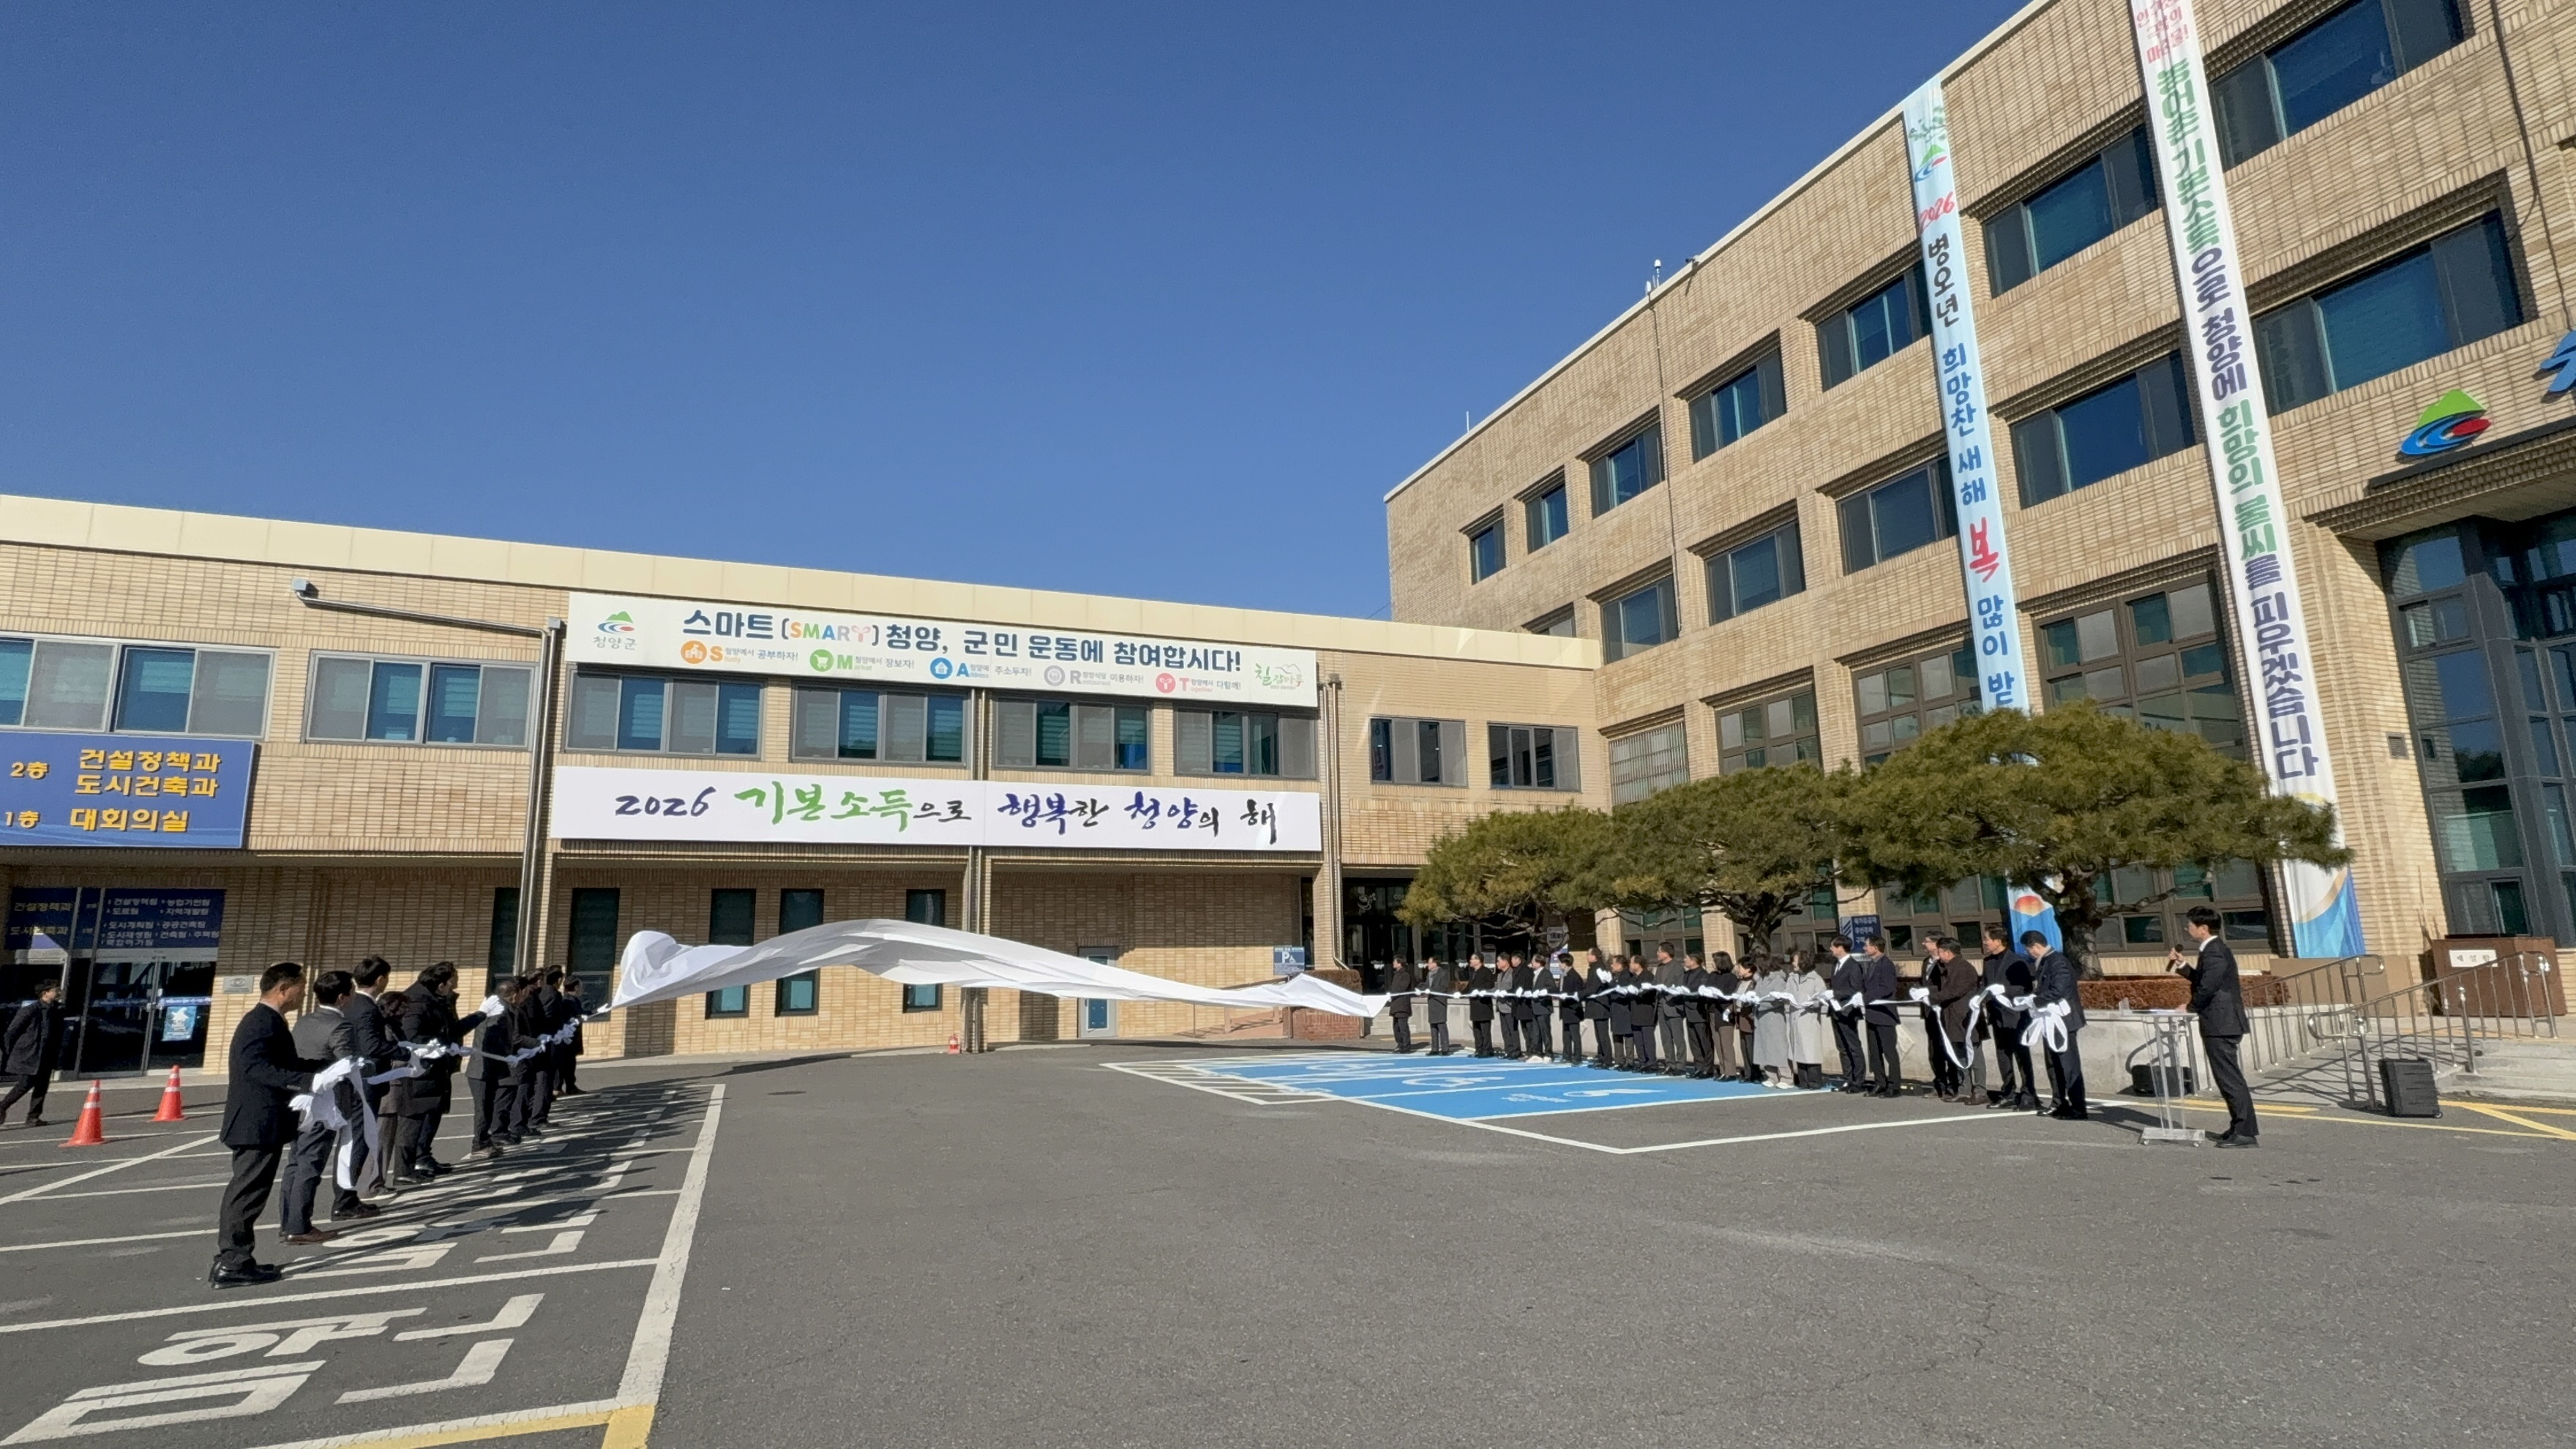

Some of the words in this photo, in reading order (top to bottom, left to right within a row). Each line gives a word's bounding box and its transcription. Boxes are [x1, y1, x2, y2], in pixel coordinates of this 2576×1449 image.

[1917, 191, 1955, 236] 2026
[1928, 233, 1960, 328] 병오년
[2201, 307, 2247, 402] 청양에
[1942, 342, 1977, 438] 희망찬
[2216, 399, 2264, 495] 희망의
[1958, 444, 1987, 506] 새해
[1969, 517, 1999, 583] 복
[2234, 493, 2283, 591] 불씨를
[592, 634, 638, 651] 청양군
[682, 609, 774, 640] 스마트
[886, 624, 949, 655] 청양,
[963, 629, 1019, 657] 군민
[1028, 634, 1104, 664] 운동에
[1113, 640, 1242, 673] 참여합시다!
[1977, 594, 2008, 656] 많이
[757, 648, 799, 662] 공부하자!
[885, 657, 916, 670] 장보자!
[995, 665, 1033, 678] 주소두자!
[1109, 673, 1145, 685] 이용하자!
[1254, 662, 1305, 688] 칠갑마루
[2250, 591, 2318, 779] 피우겠습니다
[10, 761, 50, 779] 2층
[78, 748, 222, 774] 건설정책과
[74, 774, 220, 798] 도시건축과
[5, 810, 41, 829] 1층
[70, 807, 190, 833] 대회의실
[615, 786, 716, 817] 2026
[733, 780, 973, 833] 기본소득으로
[997, 792, 1110, 835] 행복한
[1124, 790, 1219, 838] 청양의
[1240, 798, 1278, 845] 해
[1281, 951, 1290, 965] P
